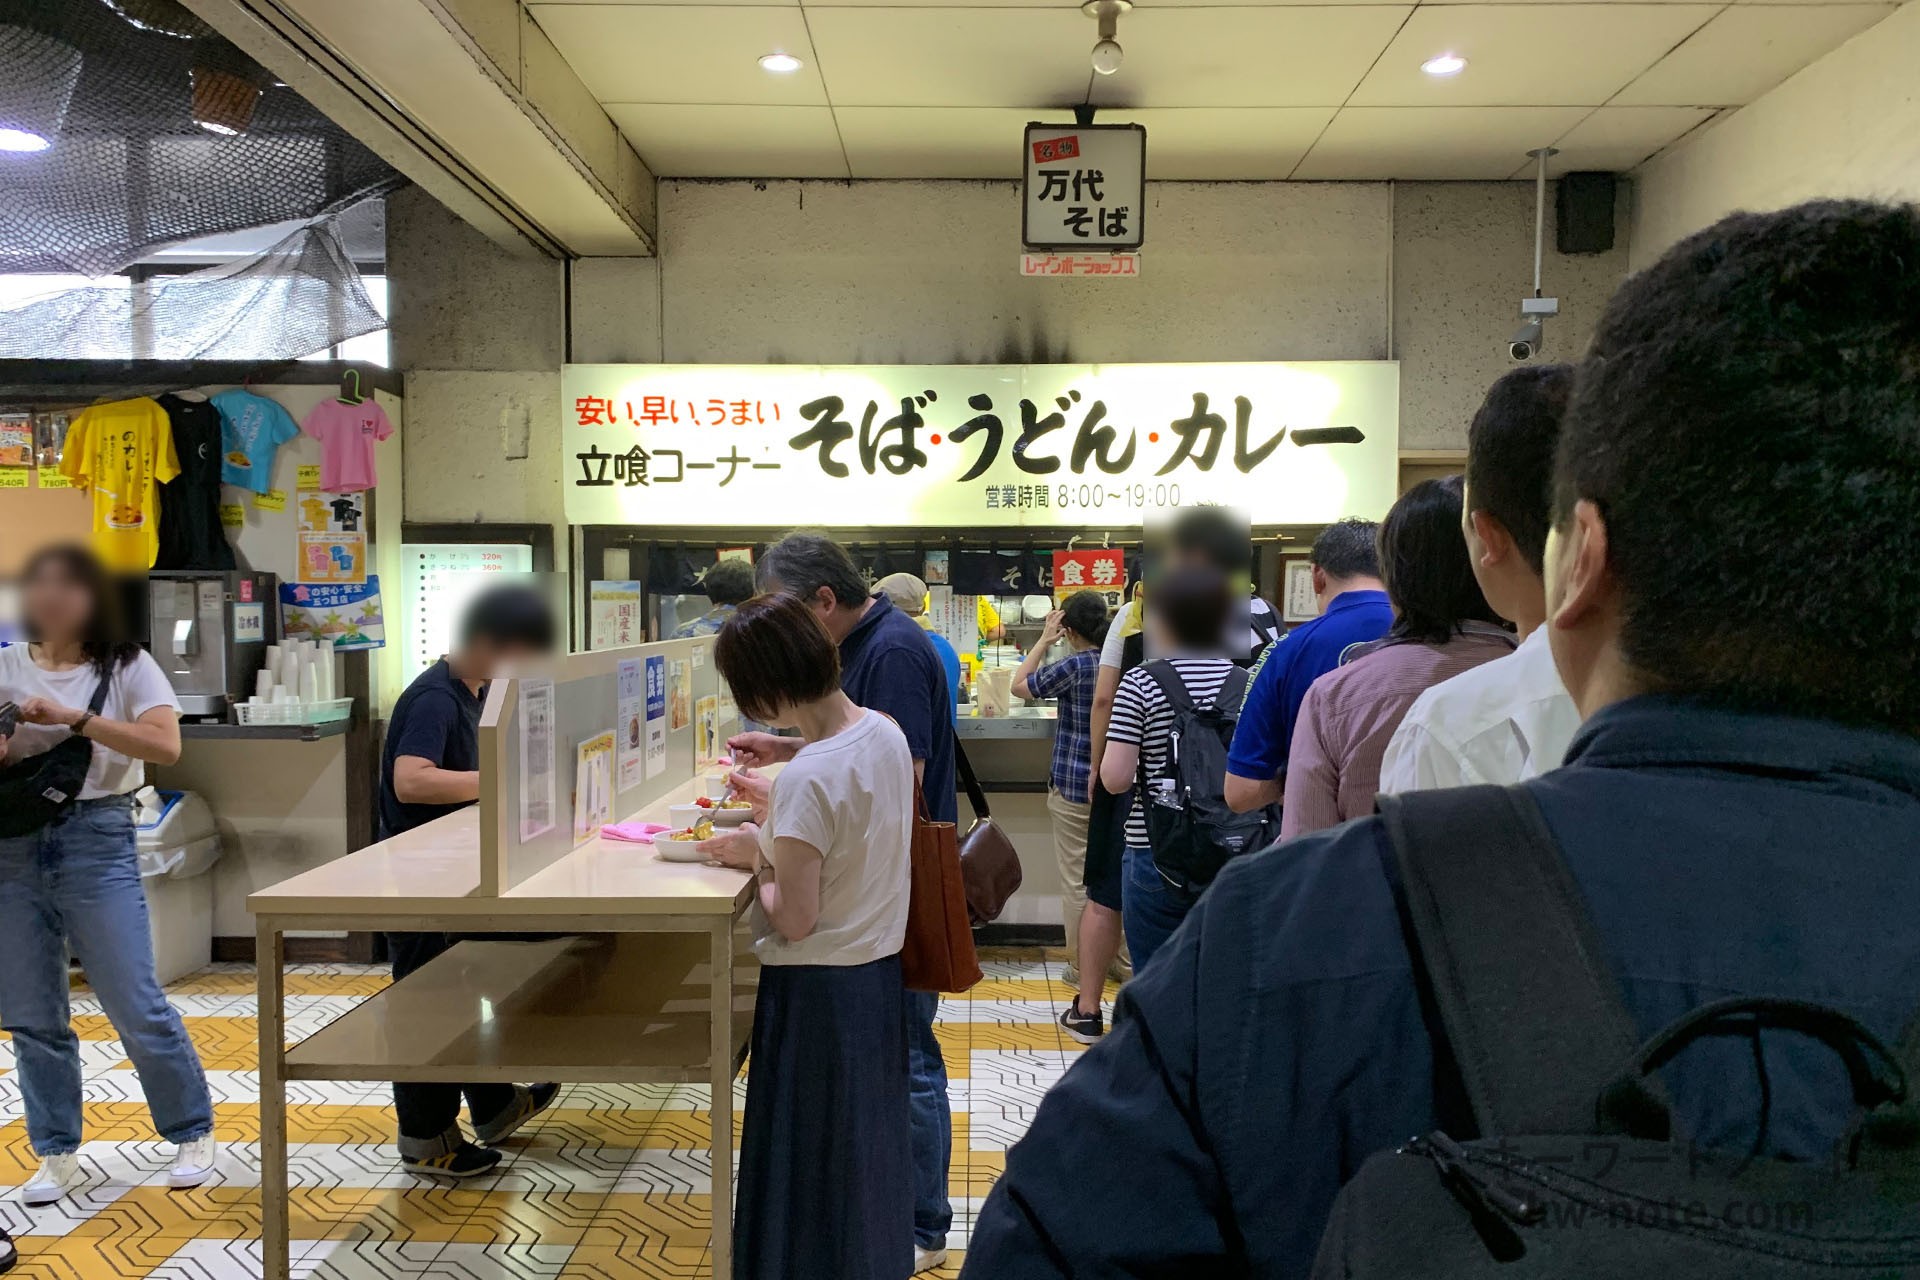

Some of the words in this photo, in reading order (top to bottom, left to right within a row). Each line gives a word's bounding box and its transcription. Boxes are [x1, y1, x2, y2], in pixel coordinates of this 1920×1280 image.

[1040, 142, 1073, 159] 名物
[1037, 169, 1105, 202] 万代
[1063, 206, 1130, 237] そば
[575, 444, 782, 488] 立喰コーナー
[985, 484, 1050, 509] 営業時間
[481, 552, 503, 561] 320円
[1058, 558, 1118, 585] 食券
[312, 595, 350, 607] 五つ星店
[618, 603, 631, 644] 国産米
[647, 664, 664, 699] 食券
